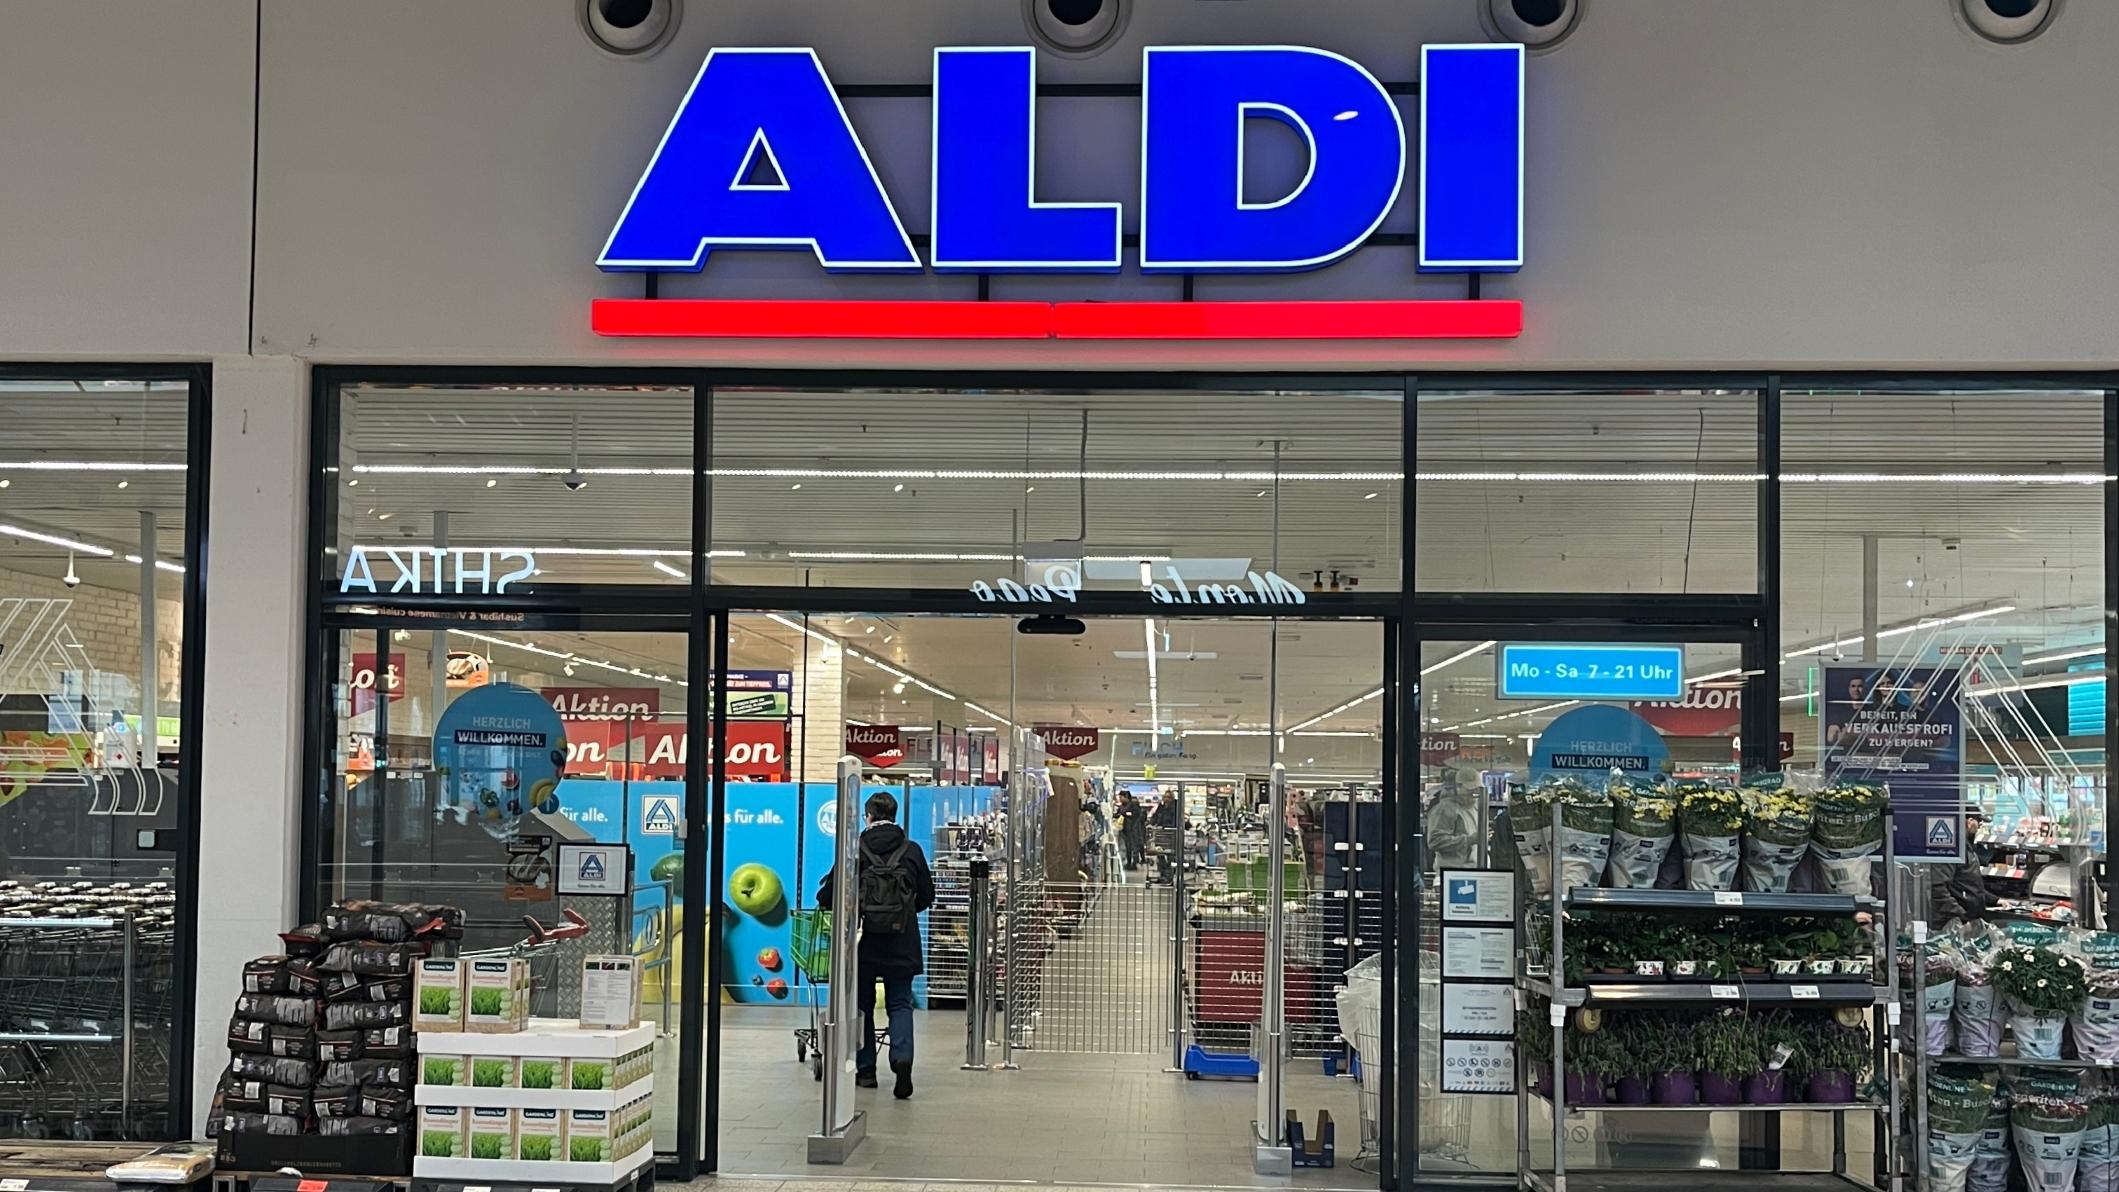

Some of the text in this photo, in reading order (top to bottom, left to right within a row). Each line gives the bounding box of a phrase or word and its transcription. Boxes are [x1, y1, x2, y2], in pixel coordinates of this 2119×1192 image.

[595, 42, 1526, 273] ALDI
[1511, 664, 1539, 679] Mo
[1556, 664, 1579, 679] Sa
[1589, 665, 1598, 679] 7
[1614, 665, 1634, 679] 21
[1640, 664, 1673, 680] Uhr
[472, 716, 532, 730] HERZLICH
[457, 731, 544, 746] WILLKOMMEN.
[846, 728, 896, 743] Aktion
[1042, 730, 1096, 746] Aktion
[1868, 738, 1882, 747] ZU
[1570, 740, 1632, 753] HERZLICH
[1555, 755, 1646, 769] WILLKOMMEN.
[581, 807, 608, 822] alle.
[734, 808, 754, 824] für
[756, 808, 784, 825] alle.
[648, 822, 673, 831] ALDI
